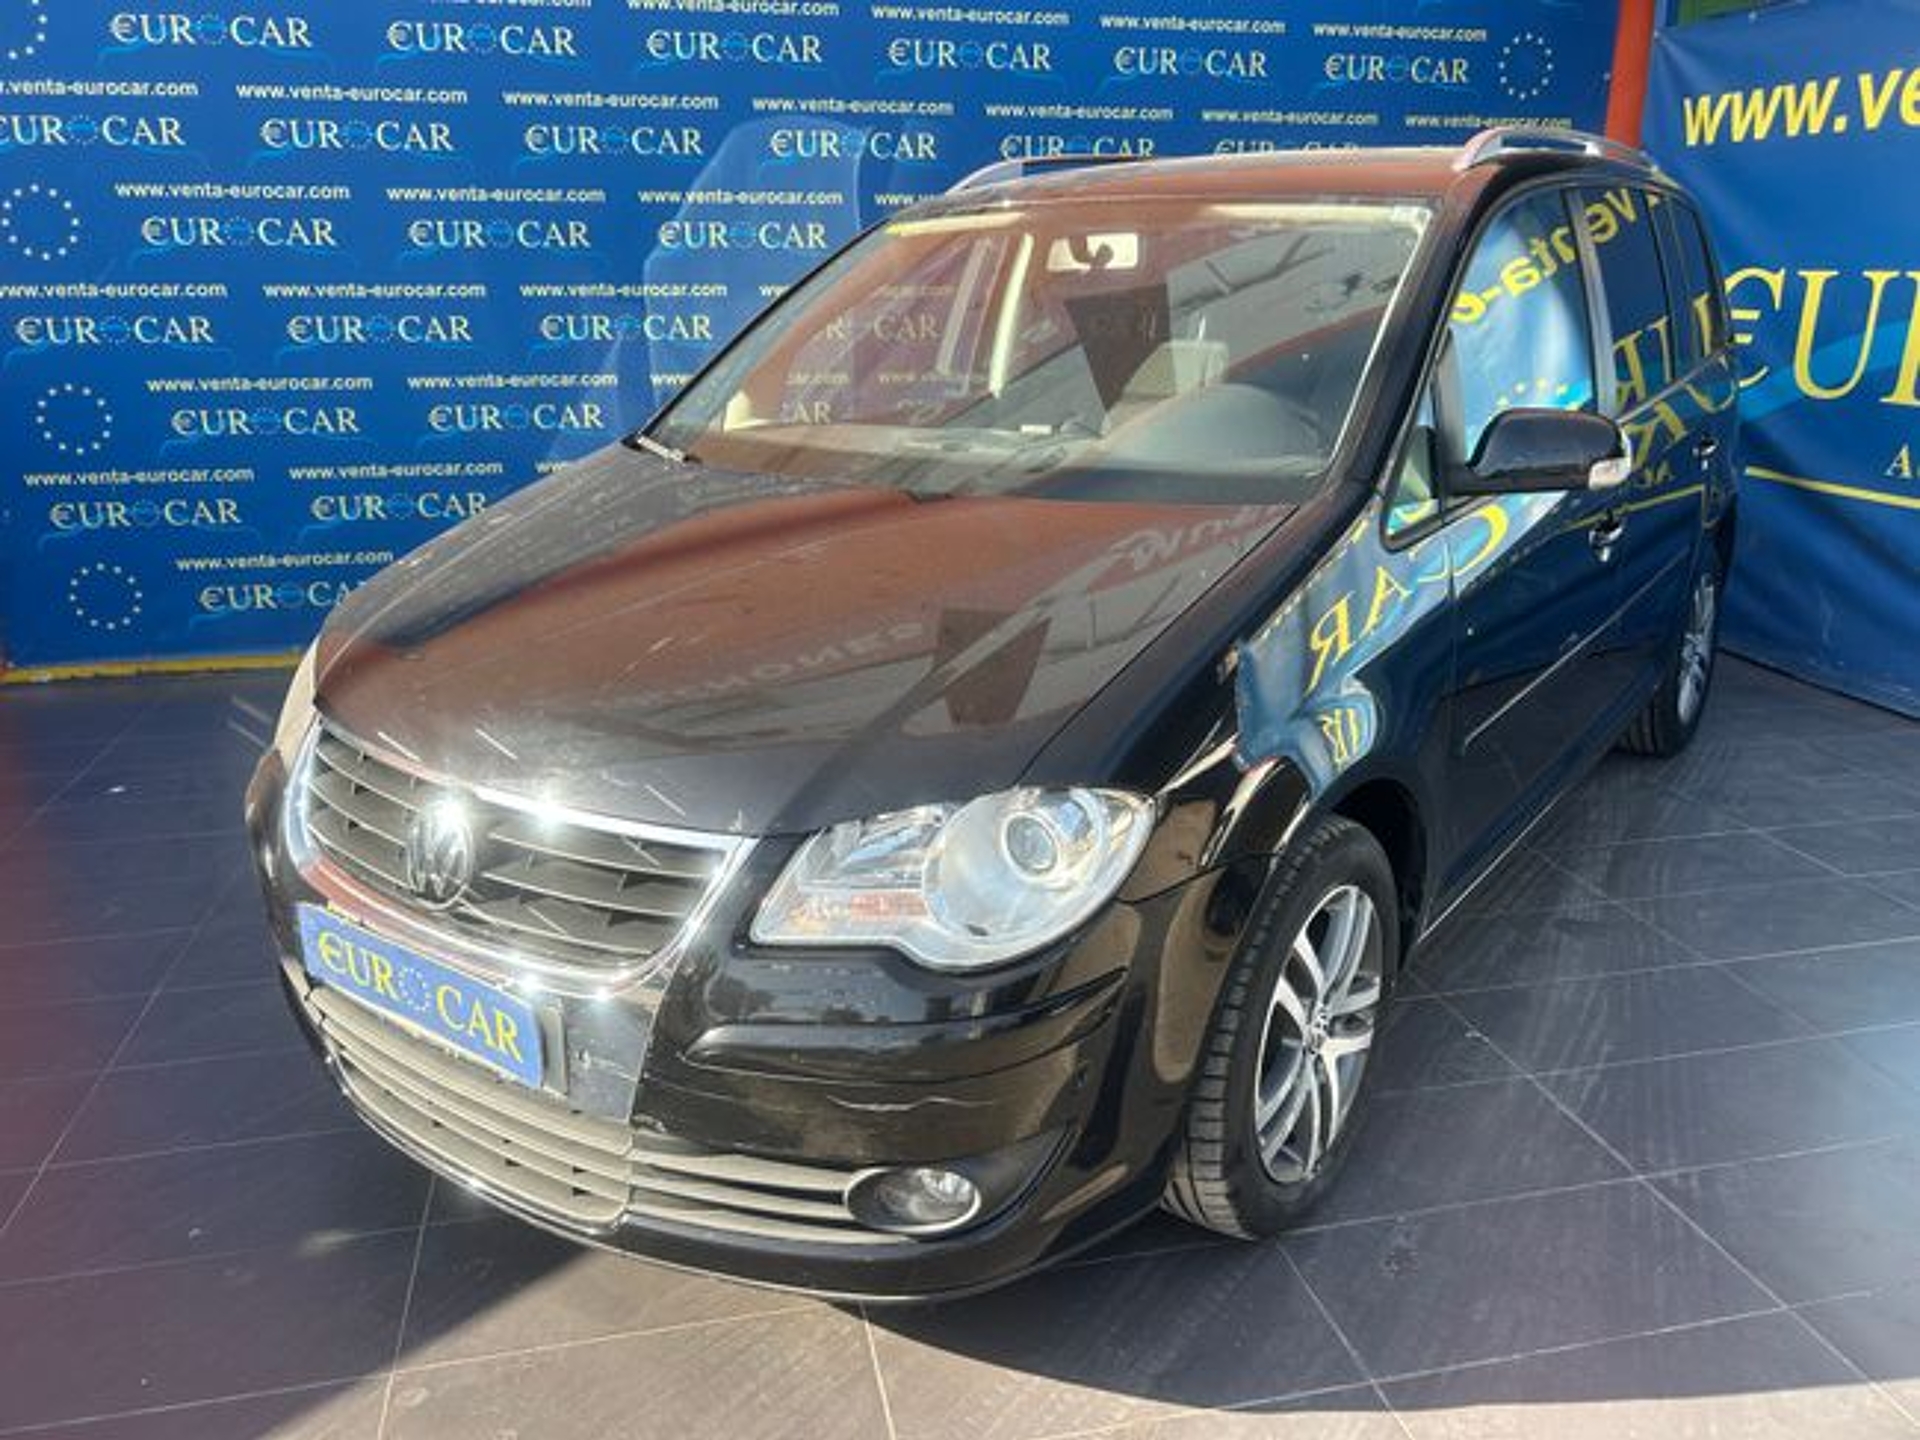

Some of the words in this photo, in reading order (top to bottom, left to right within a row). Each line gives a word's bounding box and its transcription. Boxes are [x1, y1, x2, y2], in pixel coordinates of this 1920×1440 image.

[236, 85, 467, 103] www.venta-eurocar.com
[503, 92, 718, 109] www.venta-eurocar.com
[115, 183, 349, 199] www.venta-eurocar.com
[387, 188, 604, 202] www.venta-eurocar.com
[263, 284, 485, 298] www.venta-eurocar.com
[520, 284, 727, 297] www.venta-eurocar.com
[147, 378, 372, 391] www.venta-eurocar.com
[408, 374, 618, 387] www.venta-eurocar.com
[24, 469, 254, 485] www.venta-eurocar.com
